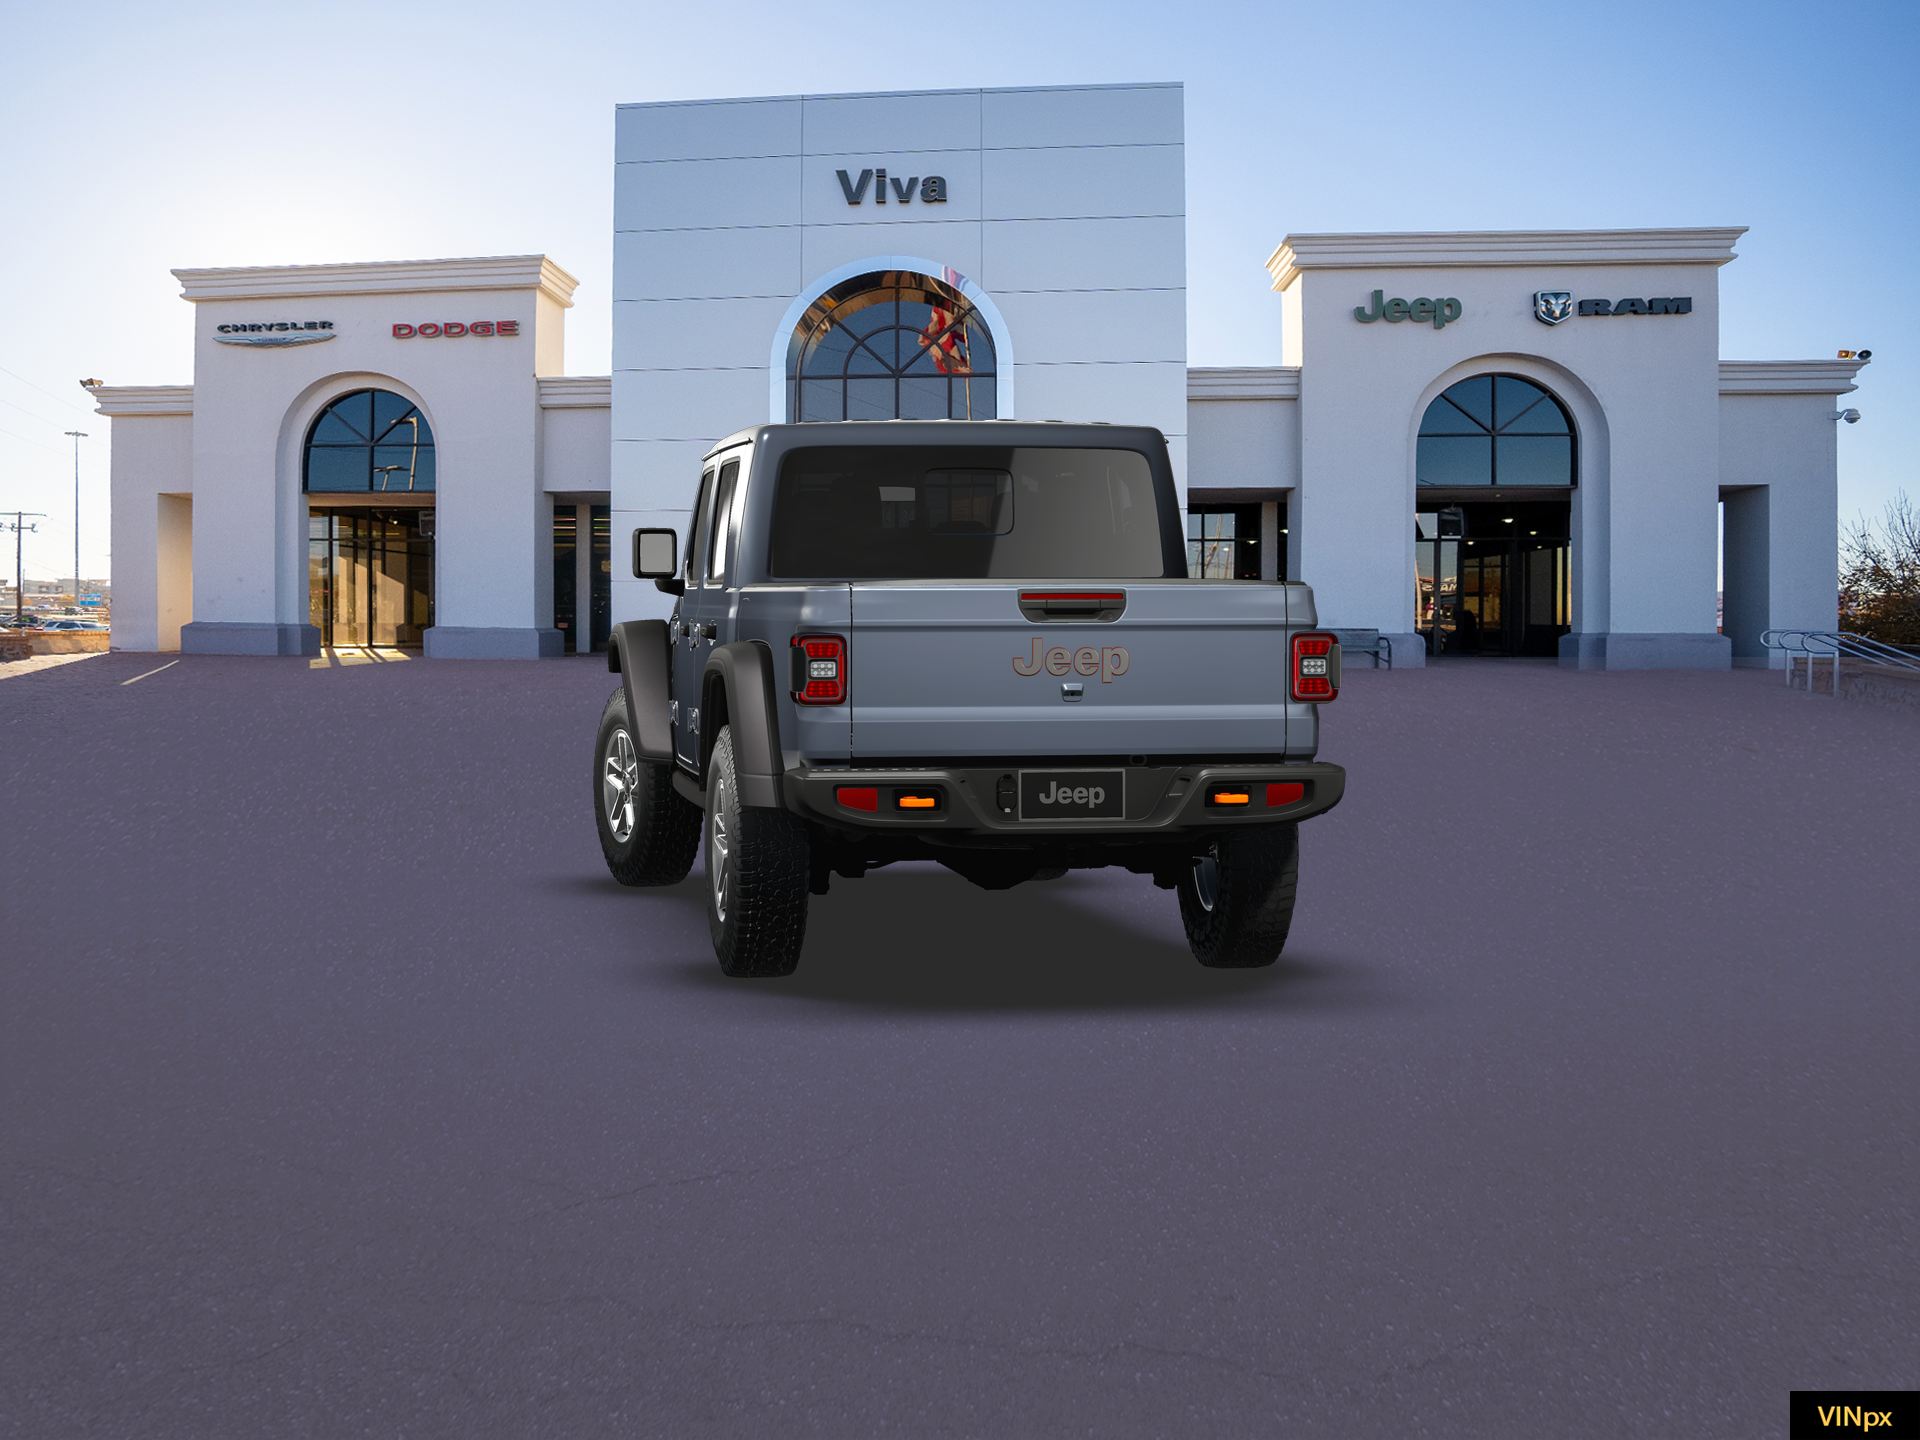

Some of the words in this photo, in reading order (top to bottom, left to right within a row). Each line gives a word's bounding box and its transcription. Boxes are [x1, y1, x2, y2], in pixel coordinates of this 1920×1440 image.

[835, 168, 947, 205] Viva
[1354, 289, 1463, 329] Jeep
[1578, 297, 1692, 316] RAM
[217, 320, 334, 334] CHRYSLER
[392, 320, 519, 339] DODGE
[1012, 637, 1130, 684] Jeep
[1039, 781, 1105, 808] Jeep
